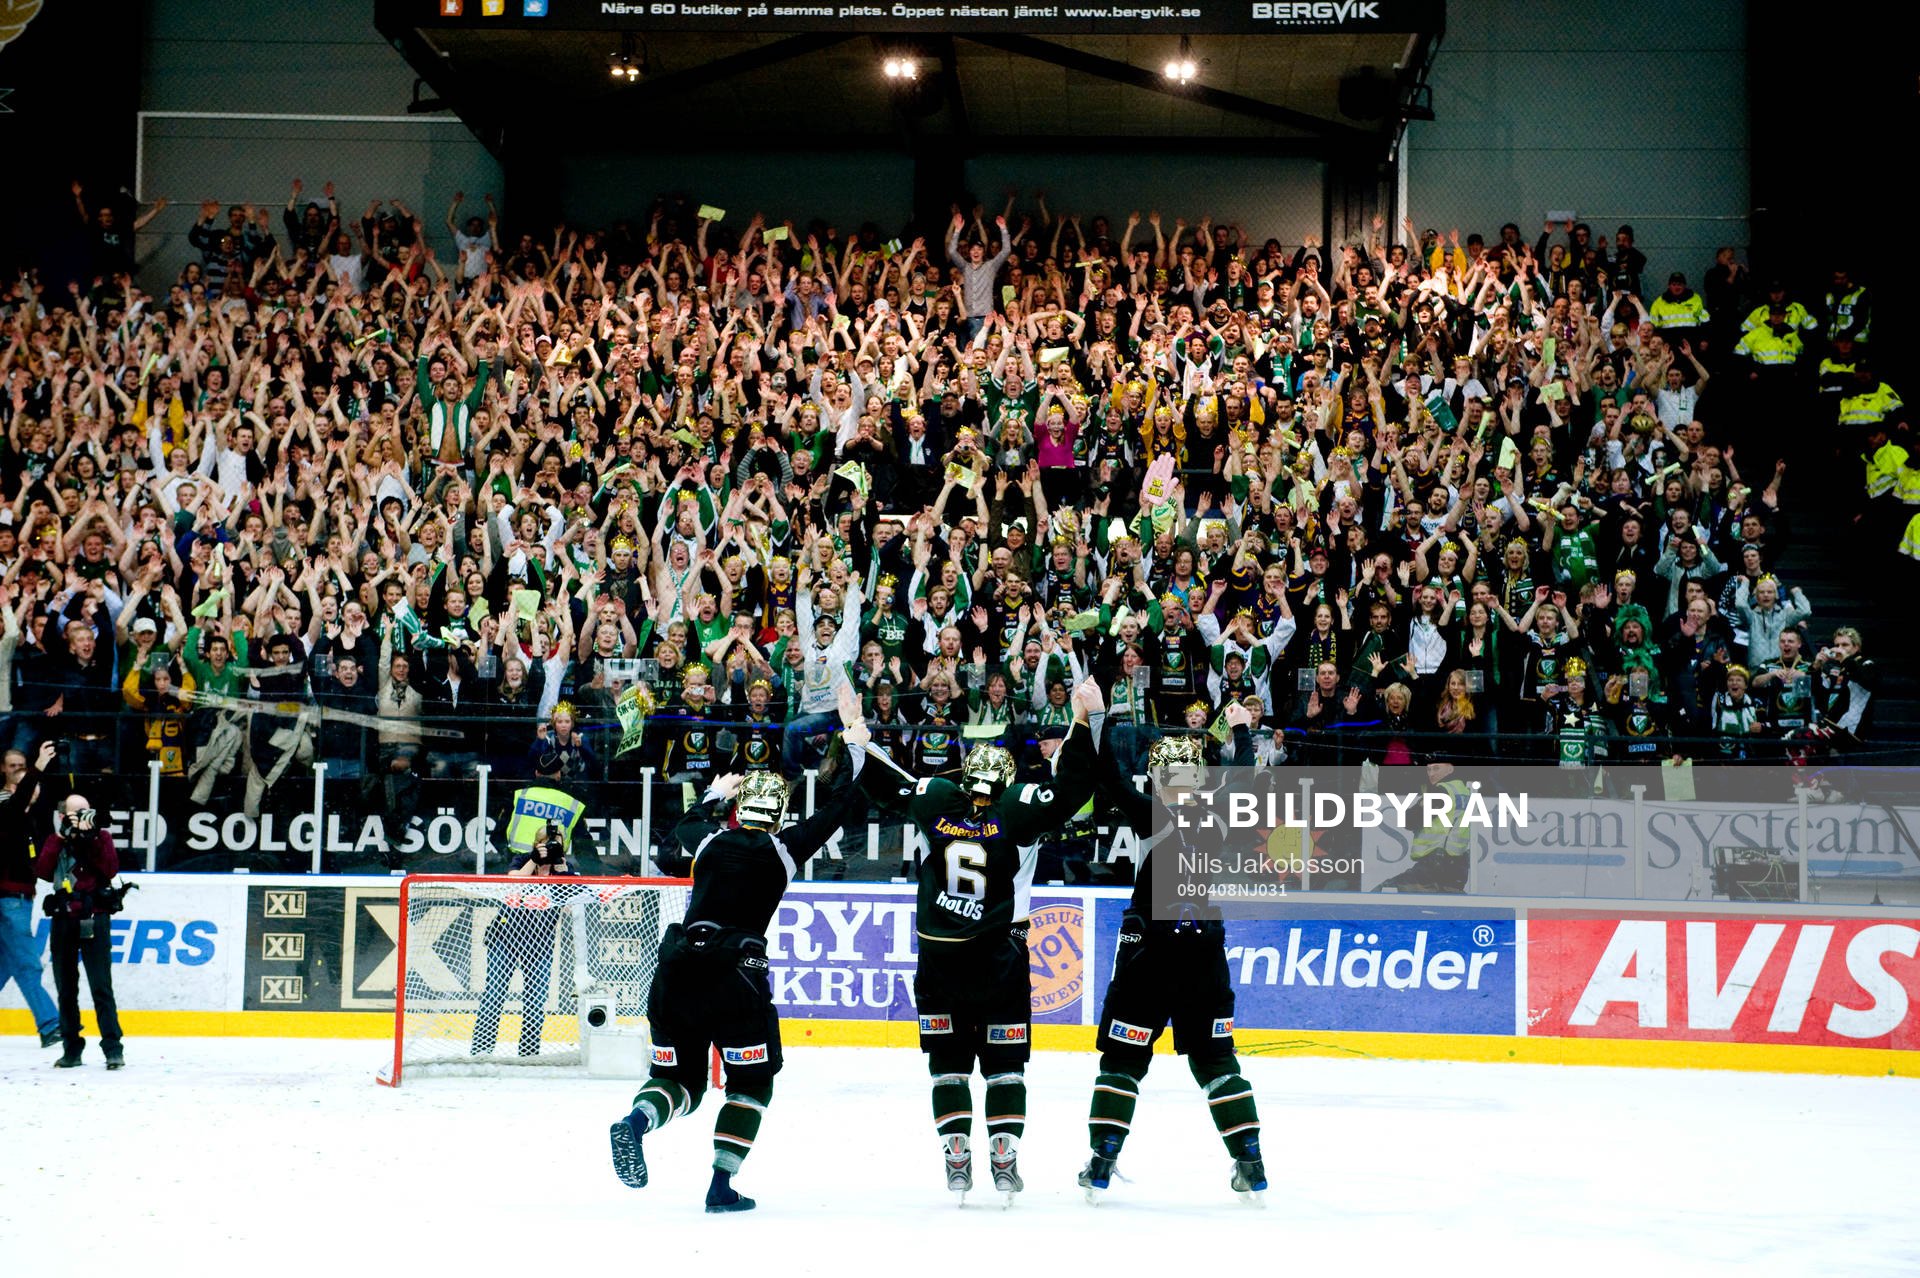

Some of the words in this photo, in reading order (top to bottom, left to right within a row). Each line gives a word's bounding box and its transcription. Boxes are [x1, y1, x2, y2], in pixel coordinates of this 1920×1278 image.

[601, 3, 644, 15] Nära
[650, 4, 676, 15] 60
[681, 4, 742, 16] butiker
[747, 3, 768, 18] på
[773, 6, 834, 16] samma
[839, 6, 888, 18] plats.
[892, 3, 944, 19] Öppet
[950, 5, 1009, 17] nästan
[1013, 5, 1058, 19] jämt!
[1064, 6, 1201, 19] www.bergvik.se
[1252, 0, 1380, 24] BERGVIK
[522, 800, 568, 822] POLIS
[99, 811, 168, 849] ED
[944, 840, 988, 901] 6
[267, 894, 304, 914] XL
[1032, 912, 1083, 928] BRUK
[768, 901, 918, 962] RYT
[265, 937, 302, 957] XL
[1224, 928, 1498, 991] rnkläder
[263, 979, 301, 999] XL
[1567, 920, 1920, 1039] AVIS
[921, 1018, 950, 1031] ELON
[990, 1028, 1026, 1041] ELON
[1111, 1023, 1149, 1043] ELON
[1215, 1021, 1233, 1035] ELO
[726, 1048, 765, 1062] ELON
